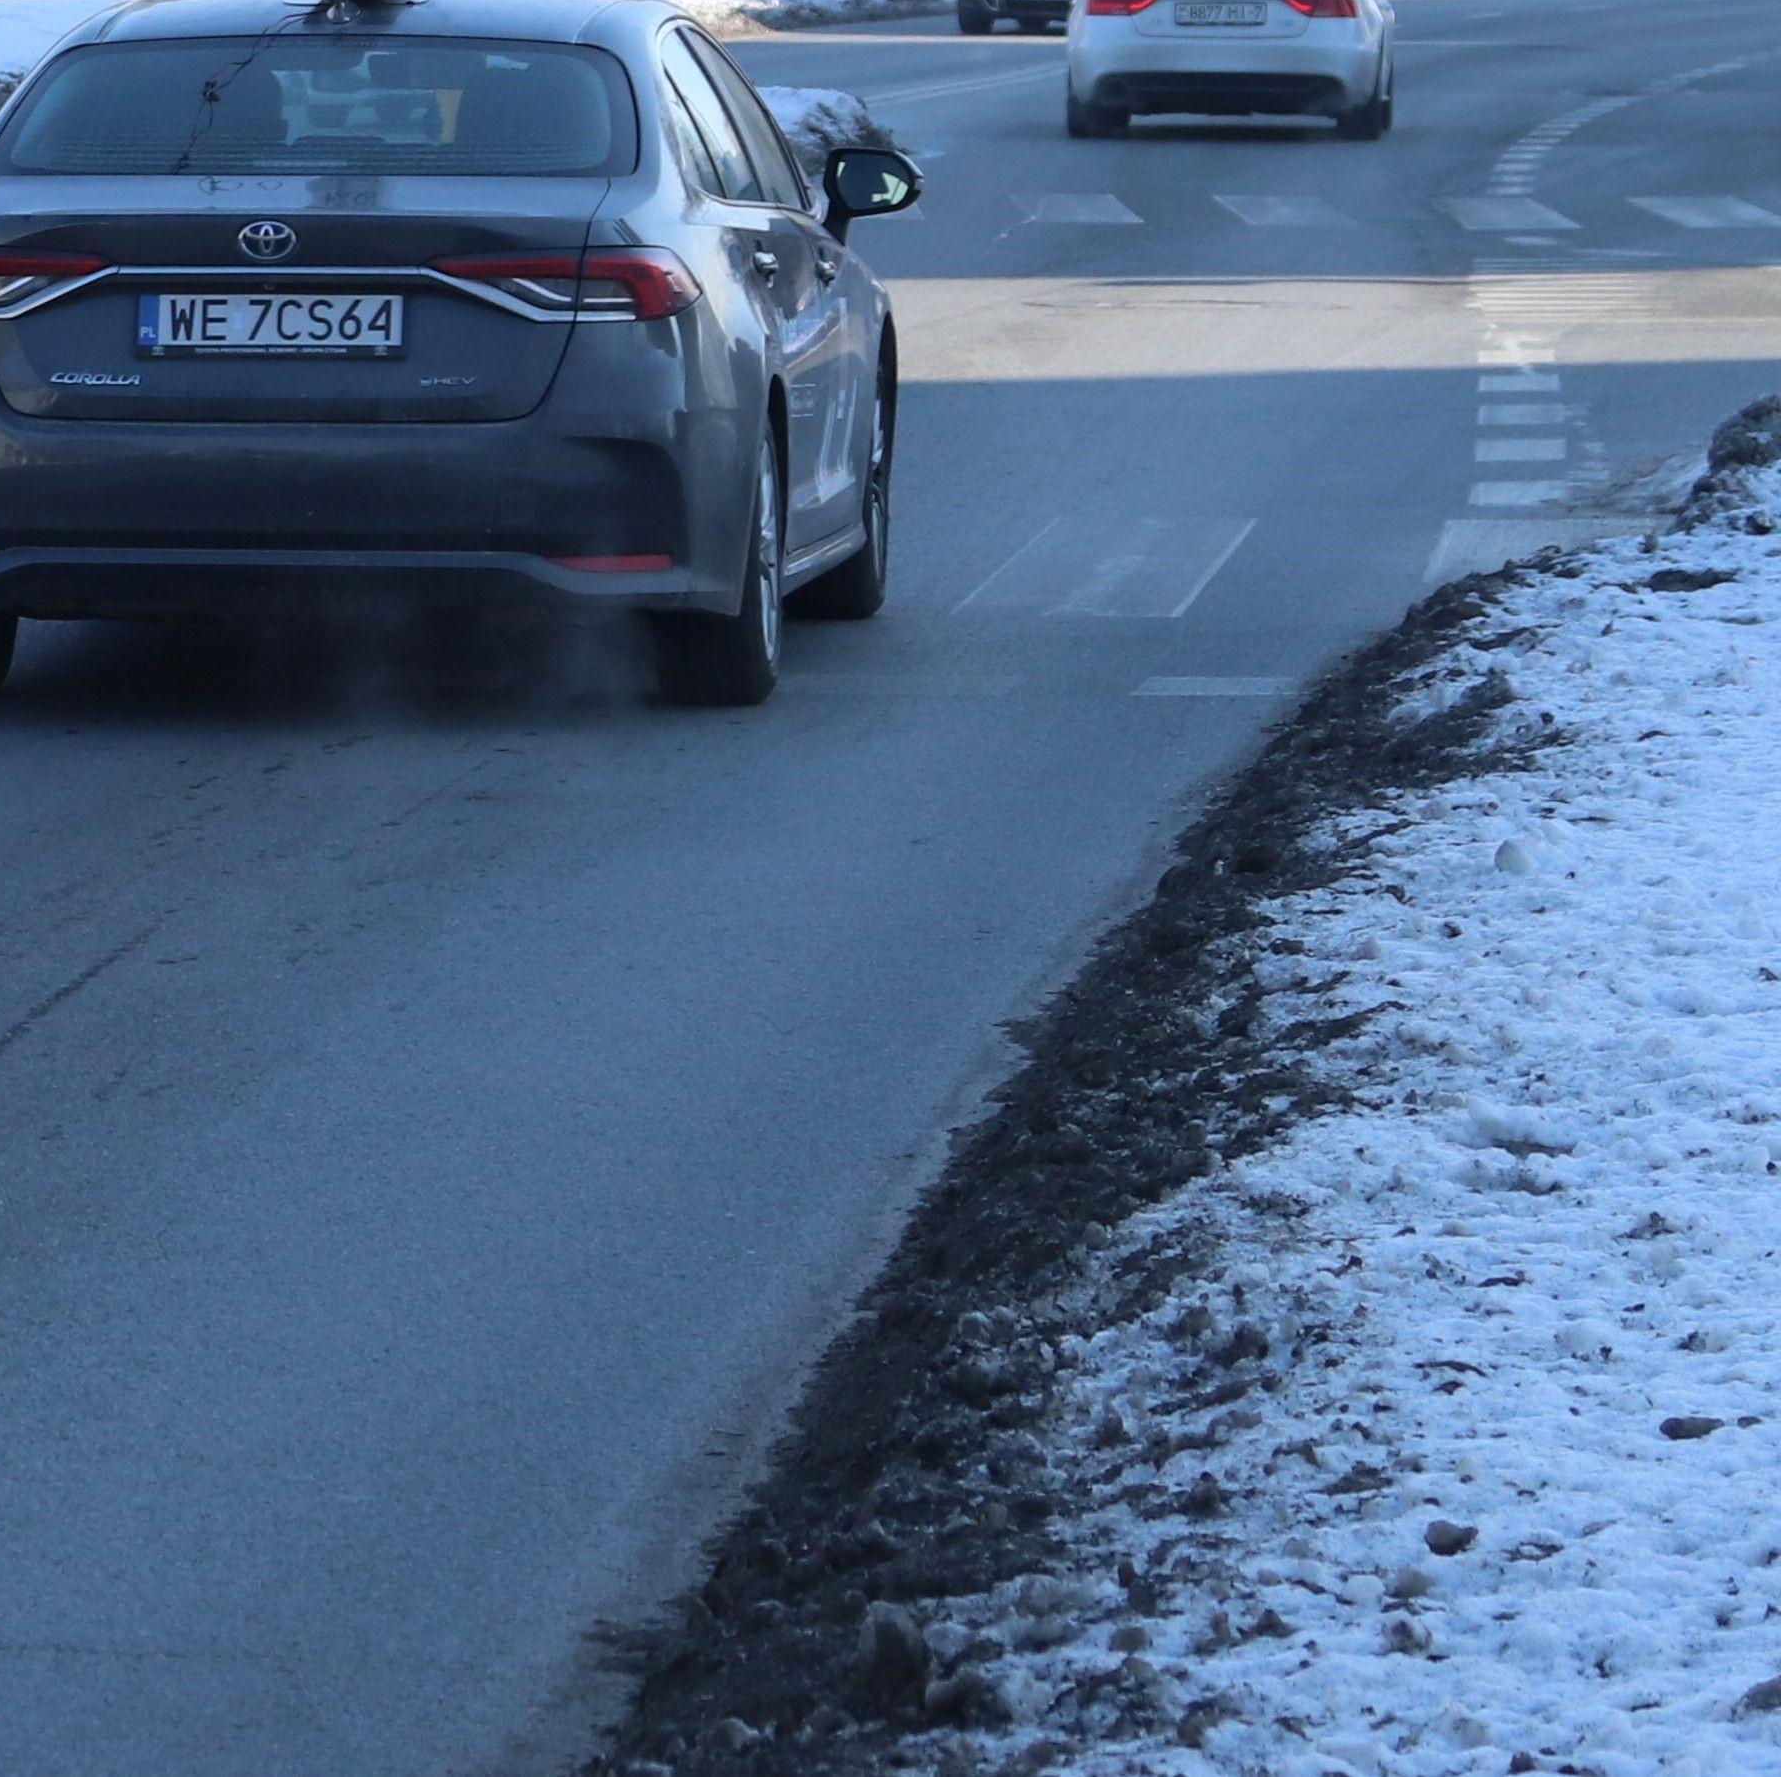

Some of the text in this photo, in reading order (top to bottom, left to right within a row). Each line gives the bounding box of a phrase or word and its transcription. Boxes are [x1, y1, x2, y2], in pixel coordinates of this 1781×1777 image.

[139, 298, 394, 342] PL WE 7CS64
[49, 371, 141, 387] COROLLA
